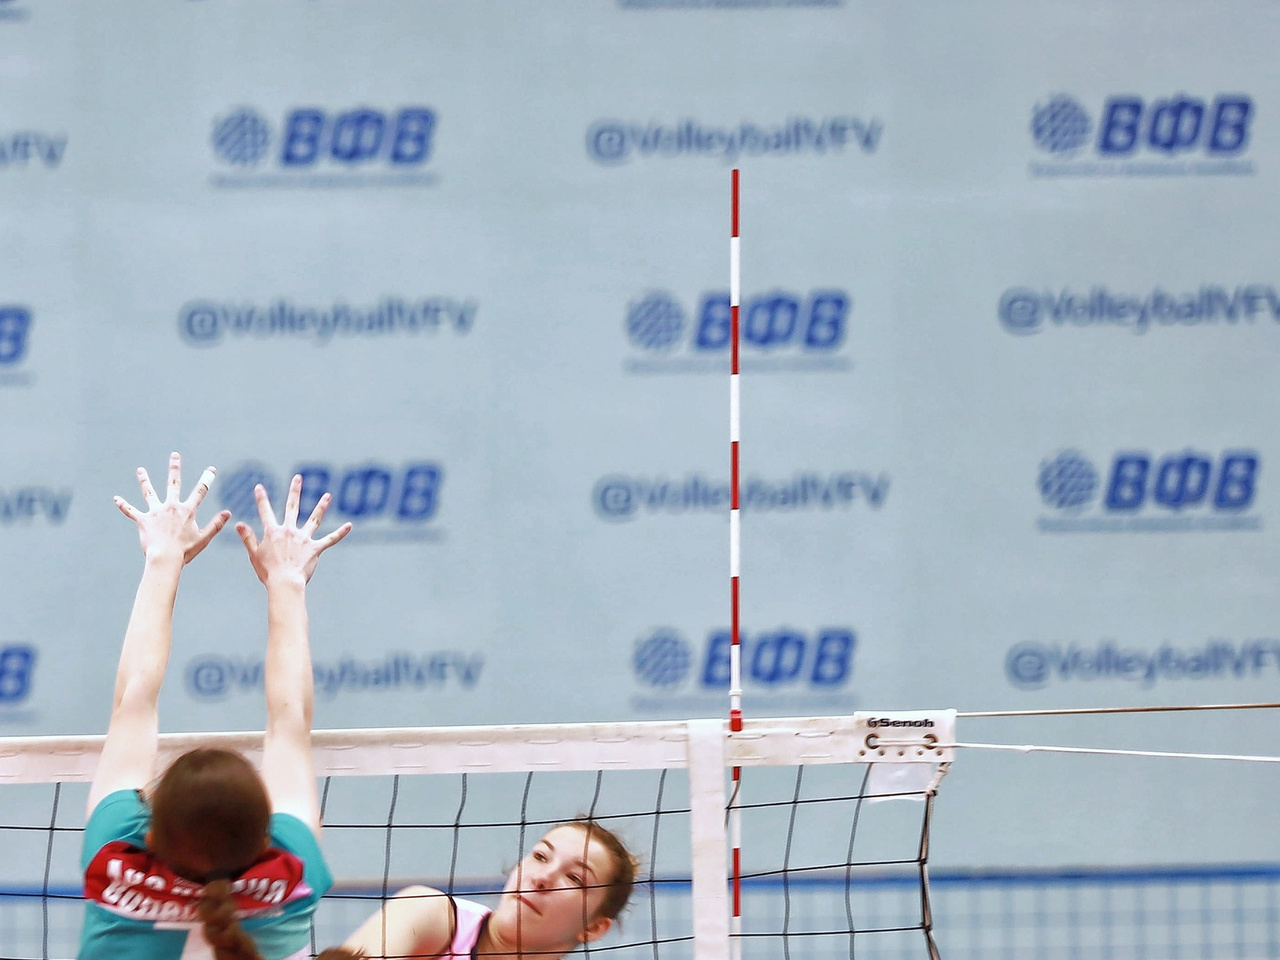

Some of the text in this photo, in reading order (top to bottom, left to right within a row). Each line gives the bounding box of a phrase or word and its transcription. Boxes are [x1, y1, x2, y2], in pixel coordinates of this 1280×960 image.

[281, 107, 437, 166] ВФВ
[1097, 94, 1254, 156] ВФВ
[692, 290, 851, 351] ВФВ
[1103, 448, 1260, 511] ВФВ
[699, 629, 855, 690] ВФВ
[879, 718, 935, 728] Senoh
